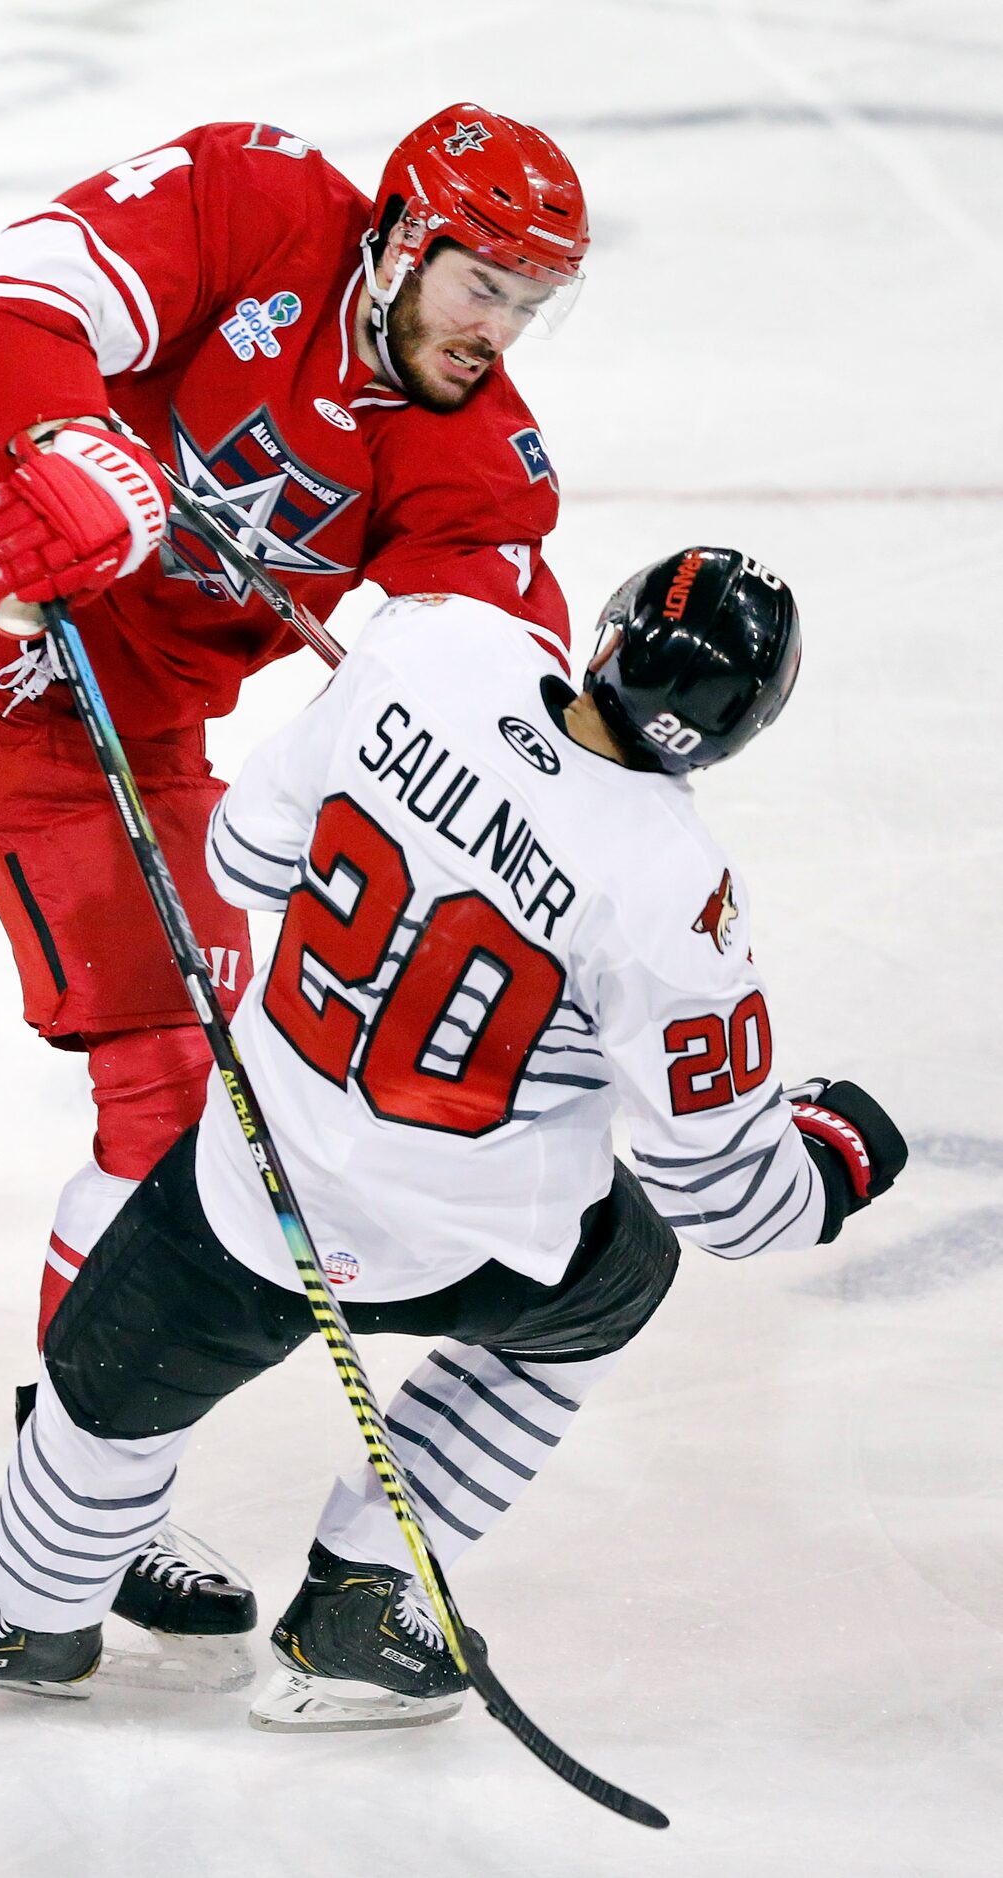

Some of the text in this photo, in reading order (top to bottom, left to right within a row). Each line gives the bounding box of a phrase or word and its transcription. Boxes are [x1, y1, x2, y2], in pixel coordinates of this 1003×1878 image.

[104, 146, 194, 204] 4
[222, 318, 254, 360] Life
[238, 299, 279, 357] Globe
[249, 421, 343, 505] ALLEN AMERICANS
[501, 718, 559, 775] AK
[643, 711, 703, 756] 20
[359, 702, 576, 941] SAULNIER
[262, 791, 567, 1139] 20
[662, 989, 773, 1117] 20
[220, 1068, 257, 1139] ALPHA
[383, 1649, 421, 1672] BAUER
